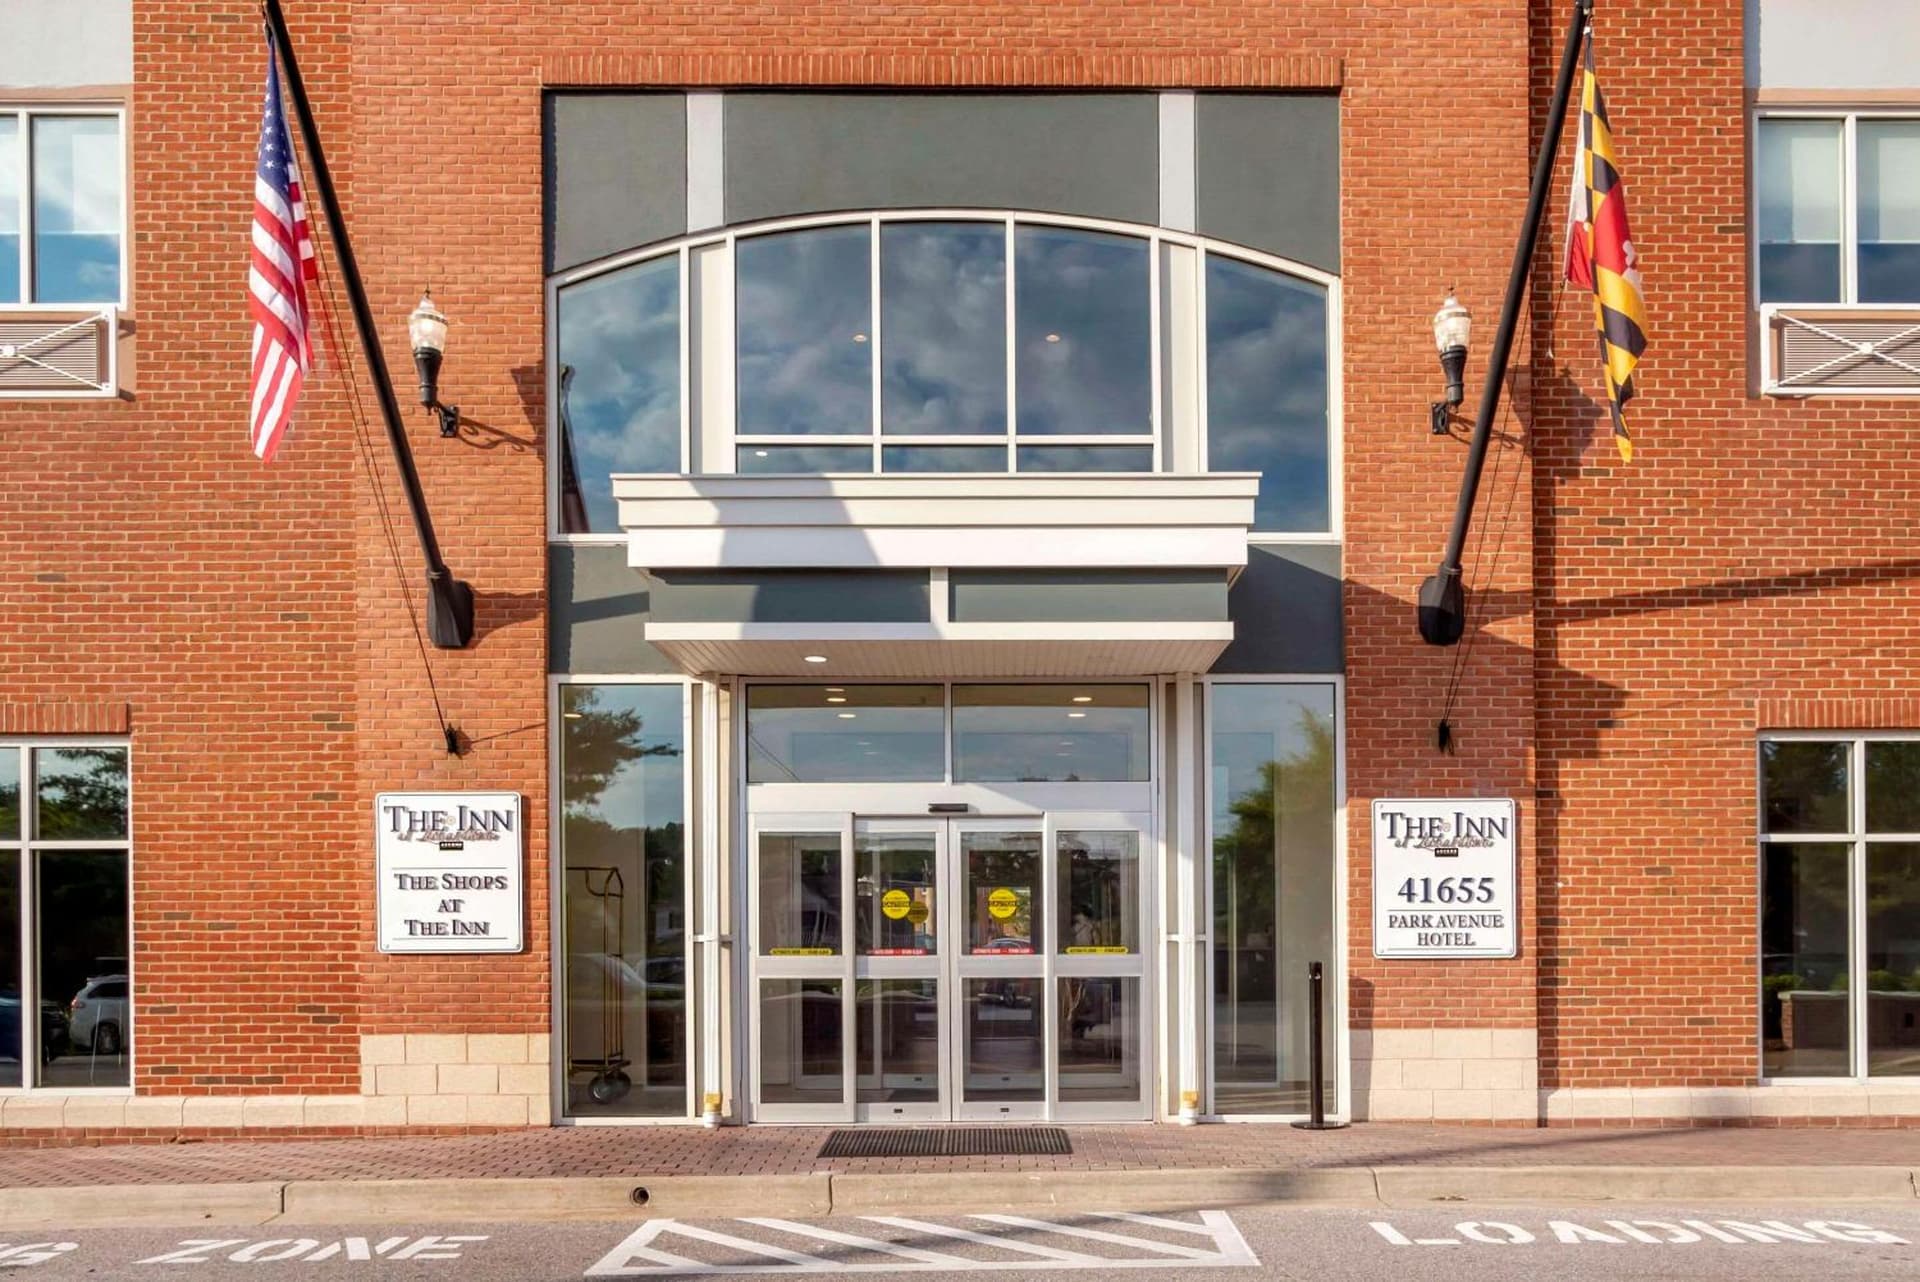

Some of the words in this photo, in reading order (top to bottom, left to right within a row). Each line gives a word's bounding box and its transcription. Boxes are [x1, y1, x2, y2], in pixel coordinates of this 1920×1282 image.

[384, 805, 449, 832] THE
[457, 805, 514, 832] INN
[1380, 812, 1444, 839] THE
[1453, 812, 1509, 839] INN
[394, 873, 439, 890] THE
[441, 873, 508, 890] SHOPS
[1398, 877, 1495, 904] 41655
[438, 899, 465, 913] AT
[404, 919, 449, 936] THE
[452, 919, 491, 936] INN
[1388, 914, 1433, 928] PARK
[1436, 914, 1505, 928] AVENUE
[1417, 932, 1476, 946] HOTEL
[1368, 1220, 1913, 1246] LOADING
[131, 1235, 490, 1264] ZONE
